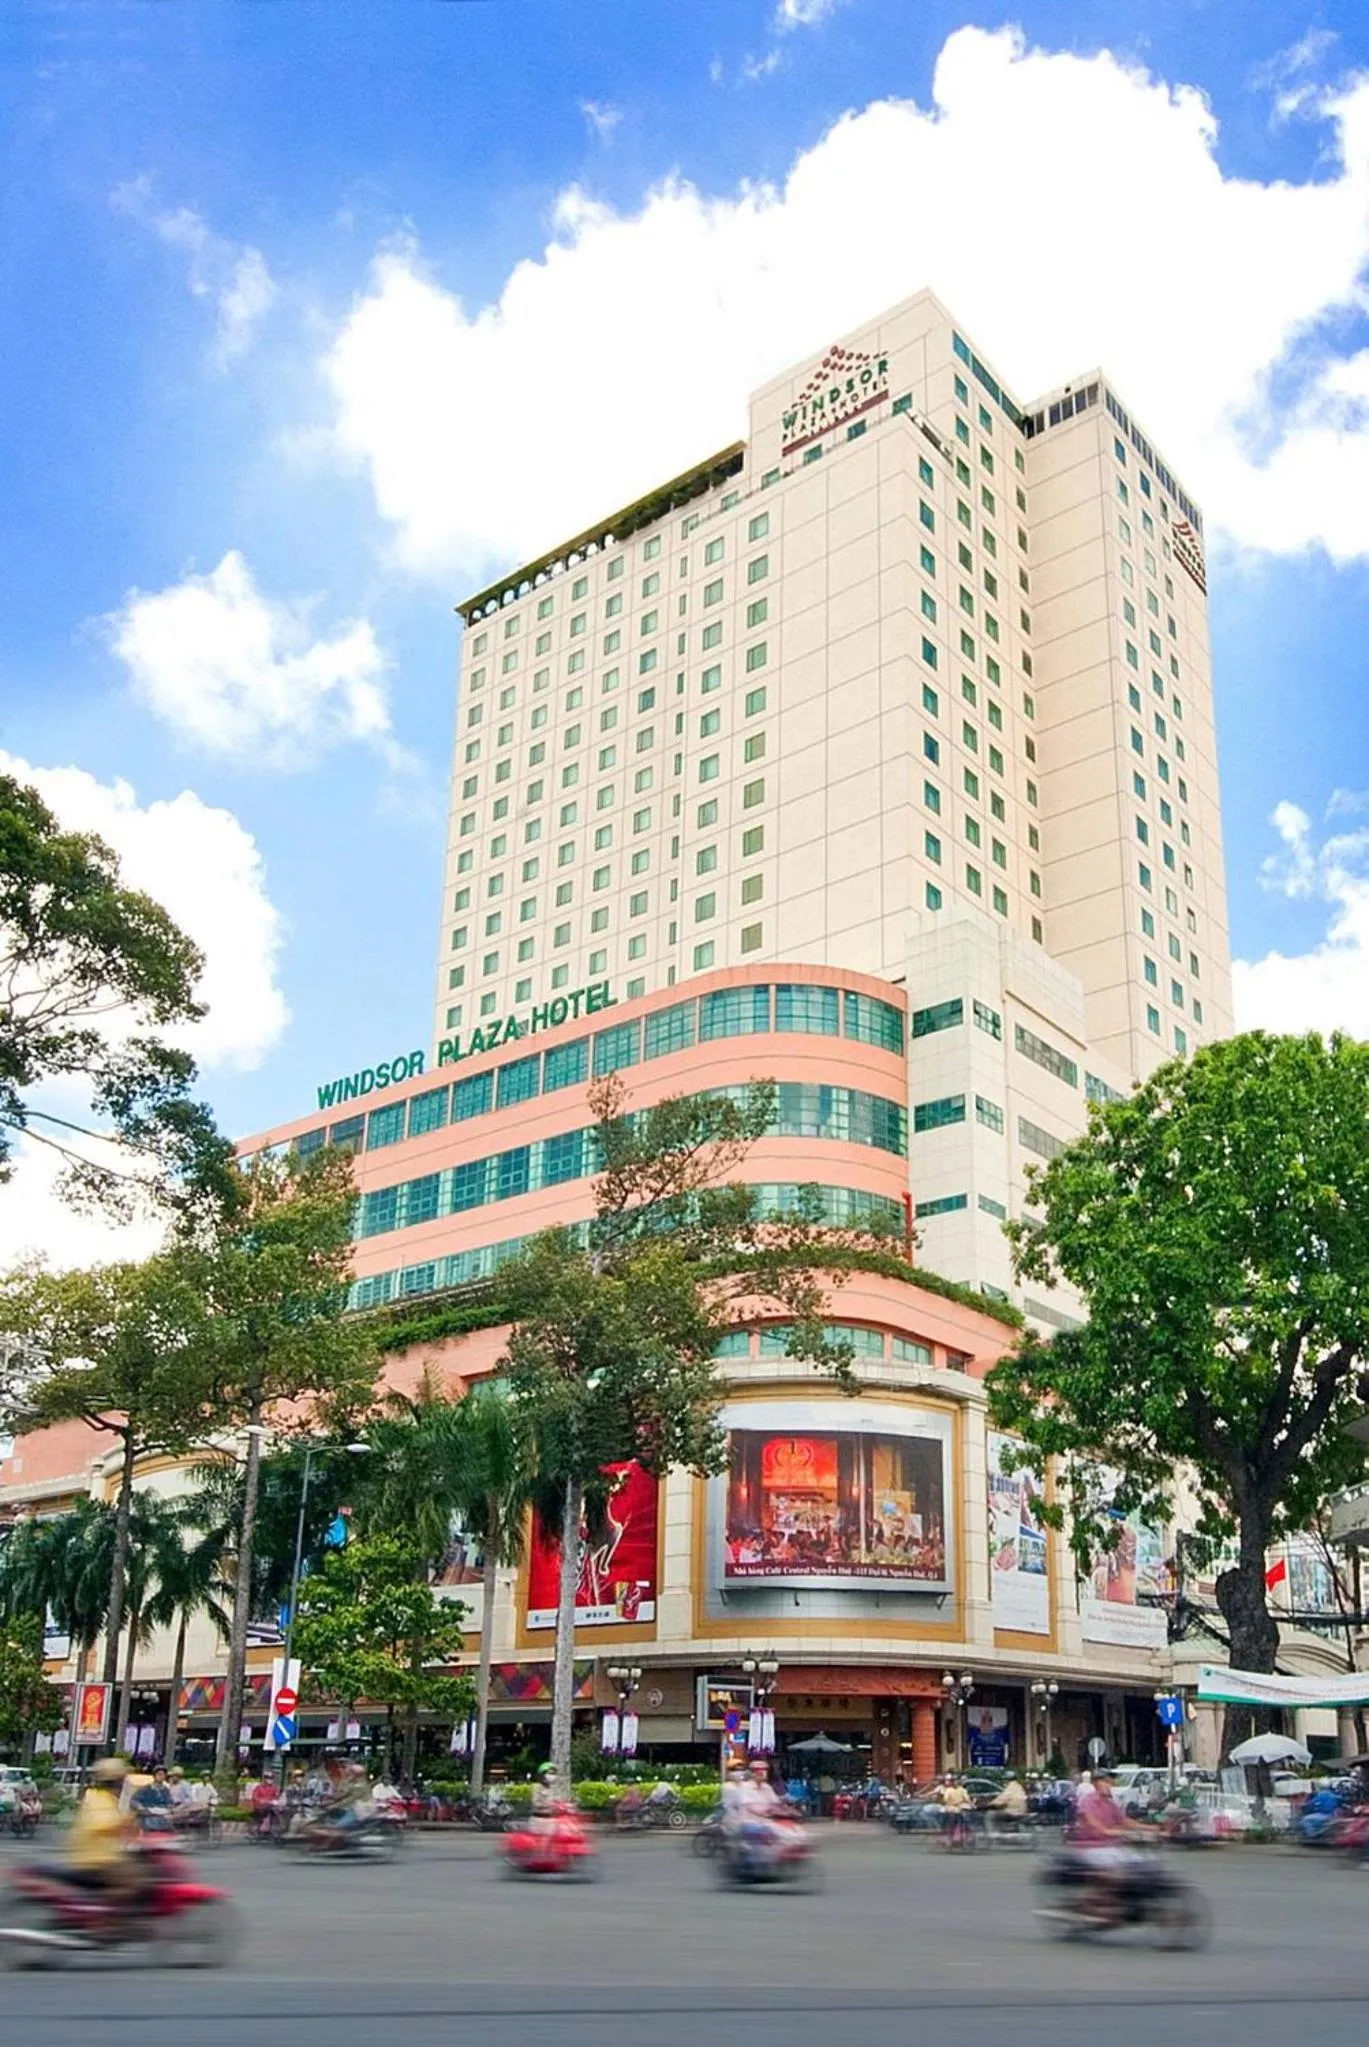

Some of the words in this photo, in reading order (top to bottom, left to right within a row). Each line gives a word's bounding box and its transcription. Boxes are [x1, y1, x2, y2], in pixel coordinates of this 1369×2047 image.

[782, 359, 888, 430] WINDSOR
[839, 377, 887, 408] HOTEL
[317, 1050, 425, 1109] WINDSOR
[437, 1014, 520, 1067] PLAZA
[530, 979, 619, 1033] HOTEL
[1167, 1703, 1176, 1719] P
